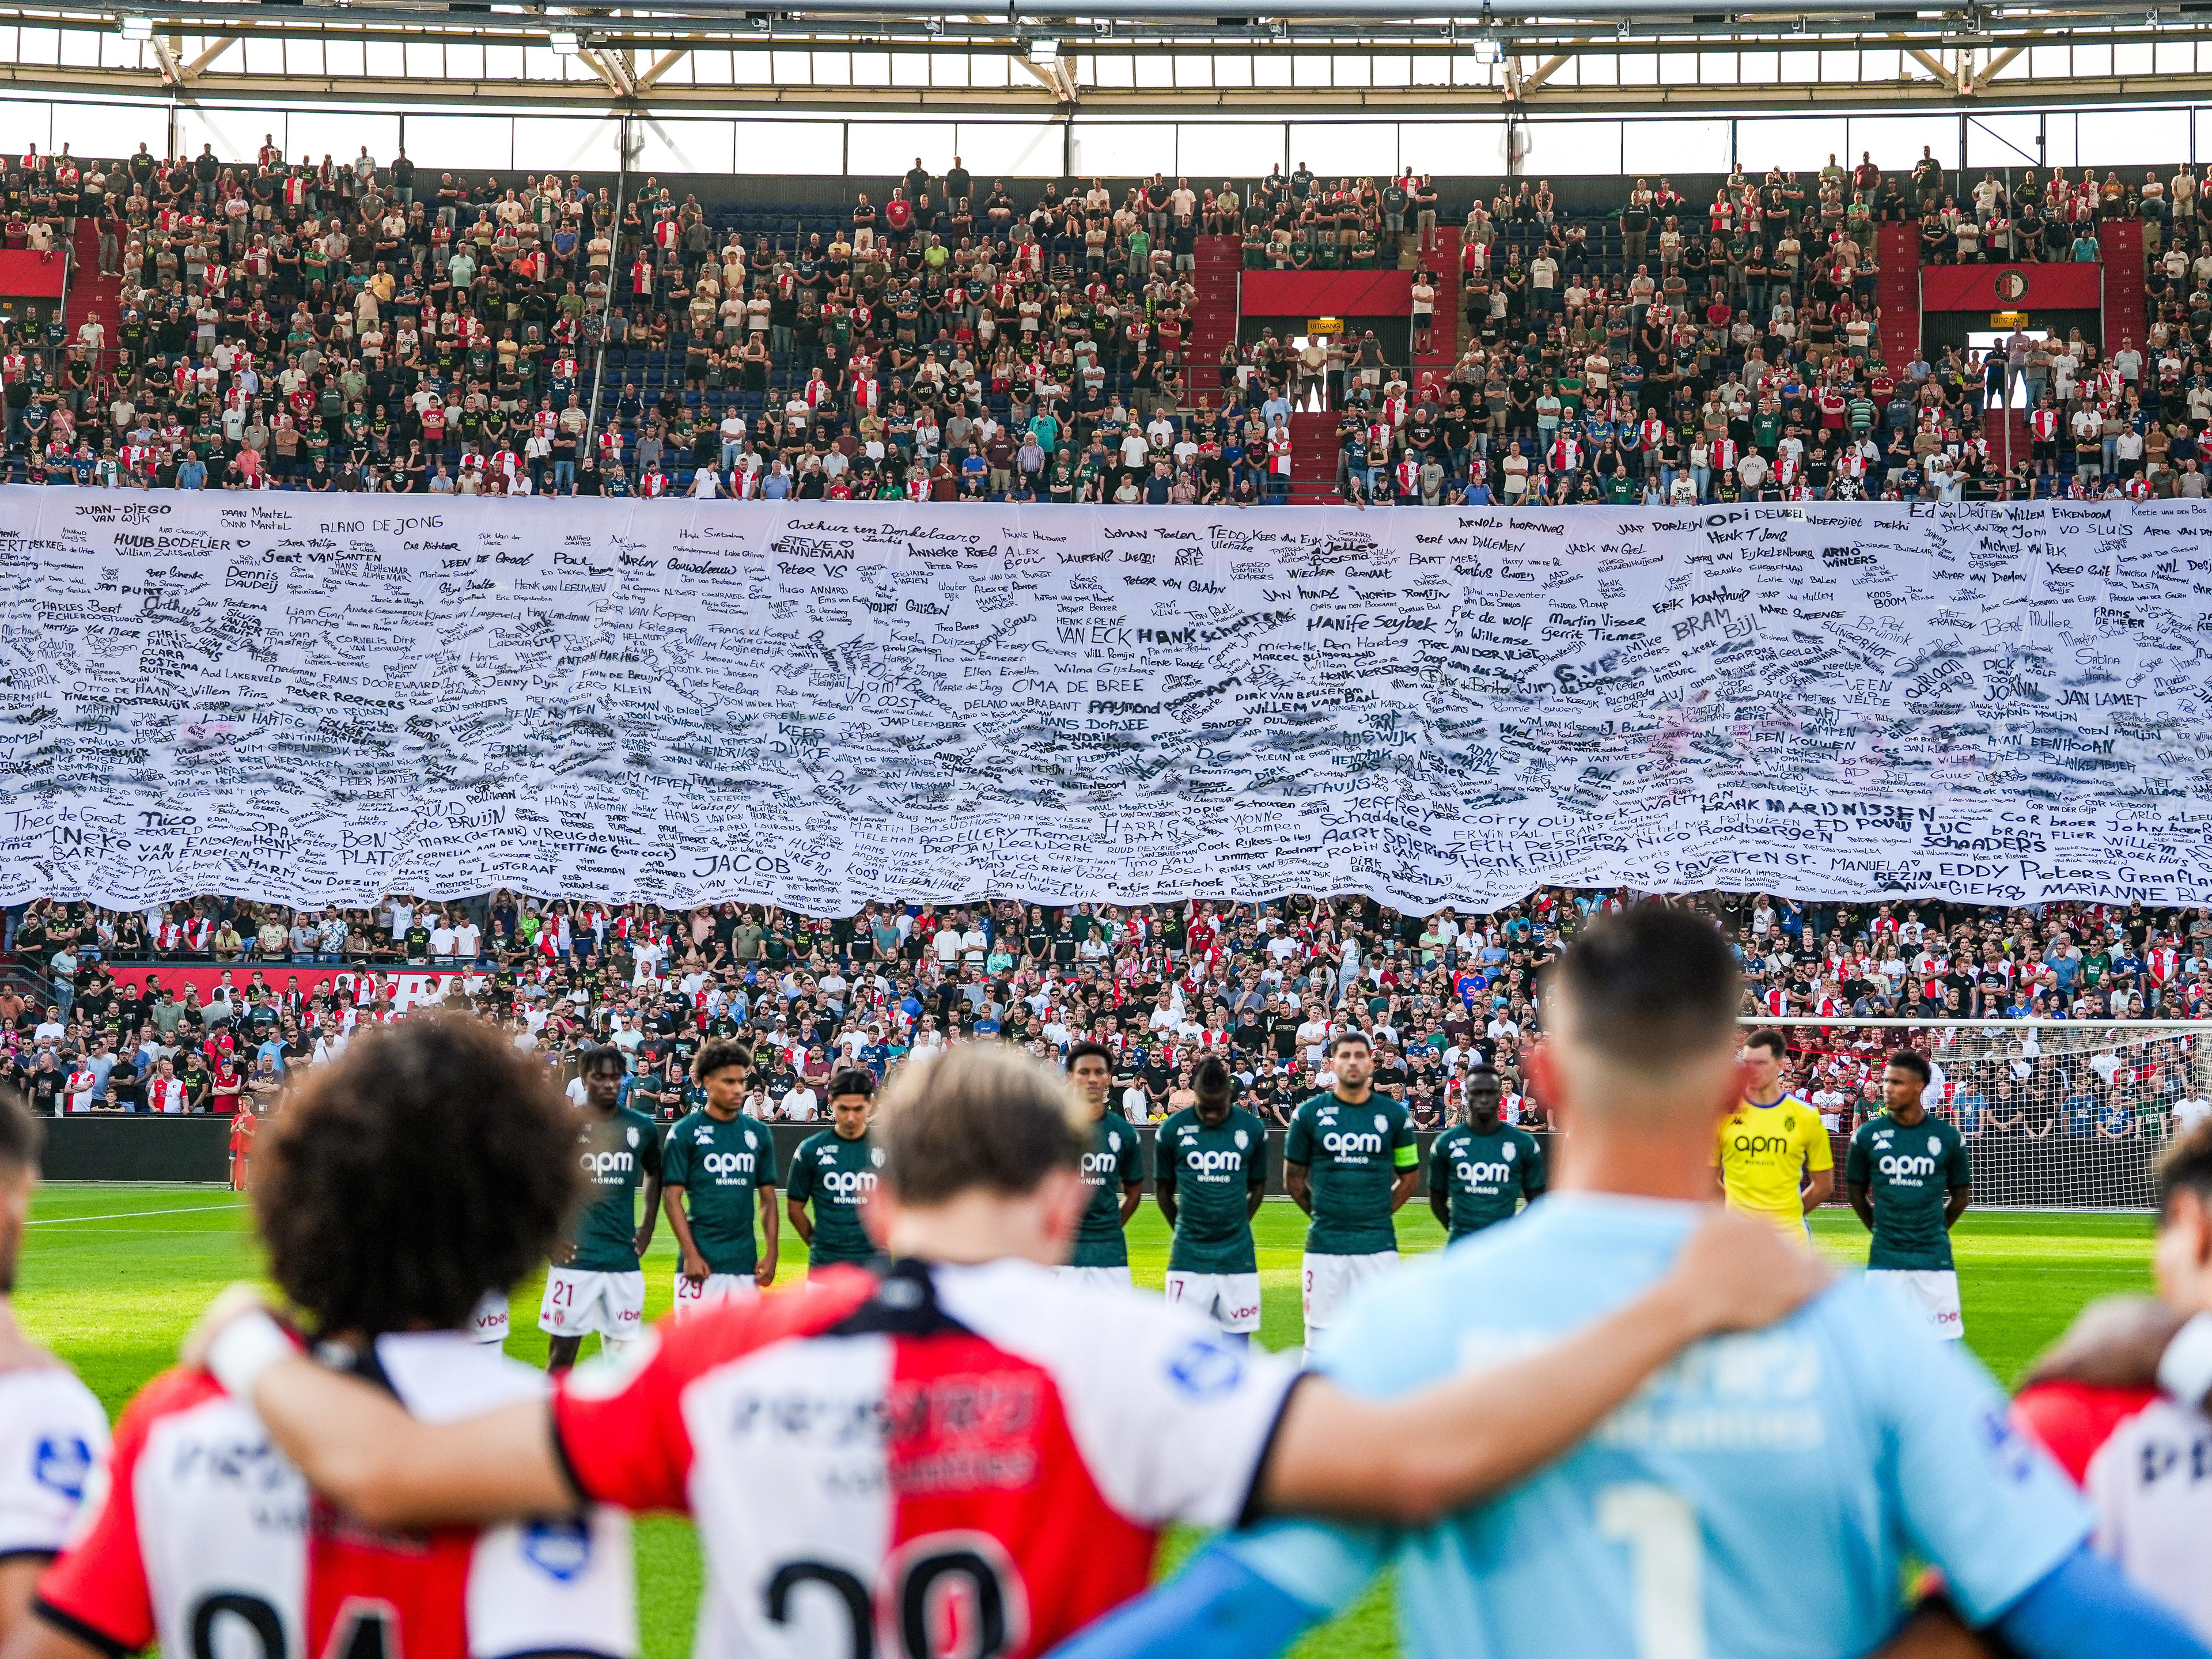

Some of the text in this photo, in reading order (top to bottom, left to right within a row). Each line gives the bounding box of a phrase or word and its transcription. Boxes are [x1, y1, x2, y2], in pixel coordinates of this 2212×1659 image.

[1755, 509, 1803, 519] DEUBEL
[373, 520, 390, 531] DE
[393, 516, 443, 535] JONG
[853, 526, 877, 535] ten
[1616, 524, 1644, 535] JAAP
[781, 536, 835, 549] STEVE
[1707, 530, 1743, 544] HENK
[1743, 528, 1760, 540] T
[771, 543, 854, 559] VENNEMAN
[1005, 546, 1039, 560] ALEX
[1176, 547, 1203, 560] OPA
[1566, 543, 1647, 555] JACK VAN GEEL
[1821, 547, 1861, 558] ARNO
[306, 552, 334, 563] VAN
[1175, 556, 1203, 566] ARIE
[1410, 553, 1445, 565] BART
[2157, 558, 2180, 573] WIL
[227, 566, 278, 580] Dennis
[515, 579, 540, 590] HENK
[560, 580, 606, 593] LEEUWEN
[1867, 591, 1892, 599] KOOS
[32, 603, 84, 611] CHARLES
[1874, 597, 1907, 608] BOOM
[1056, 617, 1083, 626] HENK
[1094, 615, 1126, 626] RENÉ
[1673, 609, 1732, 641] BRAM
[1056, 626, 1132, 647] VAN ECK
[115, 686, 129, 695] DE
[136, 683, 169, 697] HAAN
[482, 676, 528, 691] JENNY
[1012, 679, 1143, 693] OMA DE BREE
[878, 696, 921, 709] OOST
[964, 699, 1007, 710] DELANO
[1027, 697, 1081, 711] BRABANT
[2055, 690, 2148, 707] JAN LAMET
[878, 717, 967, 729] JAAP LEEMBERG
[779, 722, 825, 739] KEES
[411, 800, 465, 818] RUUD
[252, 821, 289, 838] OPA
[1512, 831, 1543, 839] PAUL
[1923, 821, 1972, 835] LUC
[139, 843, 172, 852] VAN
[253, 847, 291, 860] OTT
[923, 844, 960, 854] DROP
[961, 842, 993, 855] JAN
[138, 851, 174, 862] VAN
[336, 850, 394, 865] PLAT
[248, 859, 298, 879] HARM
[692, 854, 790, 879] JACOB
[1873, 871, 1932, 881] REZIN
[1323, 1132, 1381, 1156] apm
[1734, 1135, 1786, 1157] apm
[579, 1152, 632, 1177] apm
[703, 1153, 755, 1177] apm
[1081, 1153, 1116, 1177] pm
[1187, 1150, 1241, 1172] apm
[1879, 1156, 1935, 1180] apm
[1456, 1162, 1510, 1185] apm
[823, 1172, 877, 1193] apm
[679, 1275, 702, 1298] 29
[1306, 1271, 1313, 1291] 3
[553, 1281, 573, 1306] 21
[1169, 1280, 1184, 1303] 17
